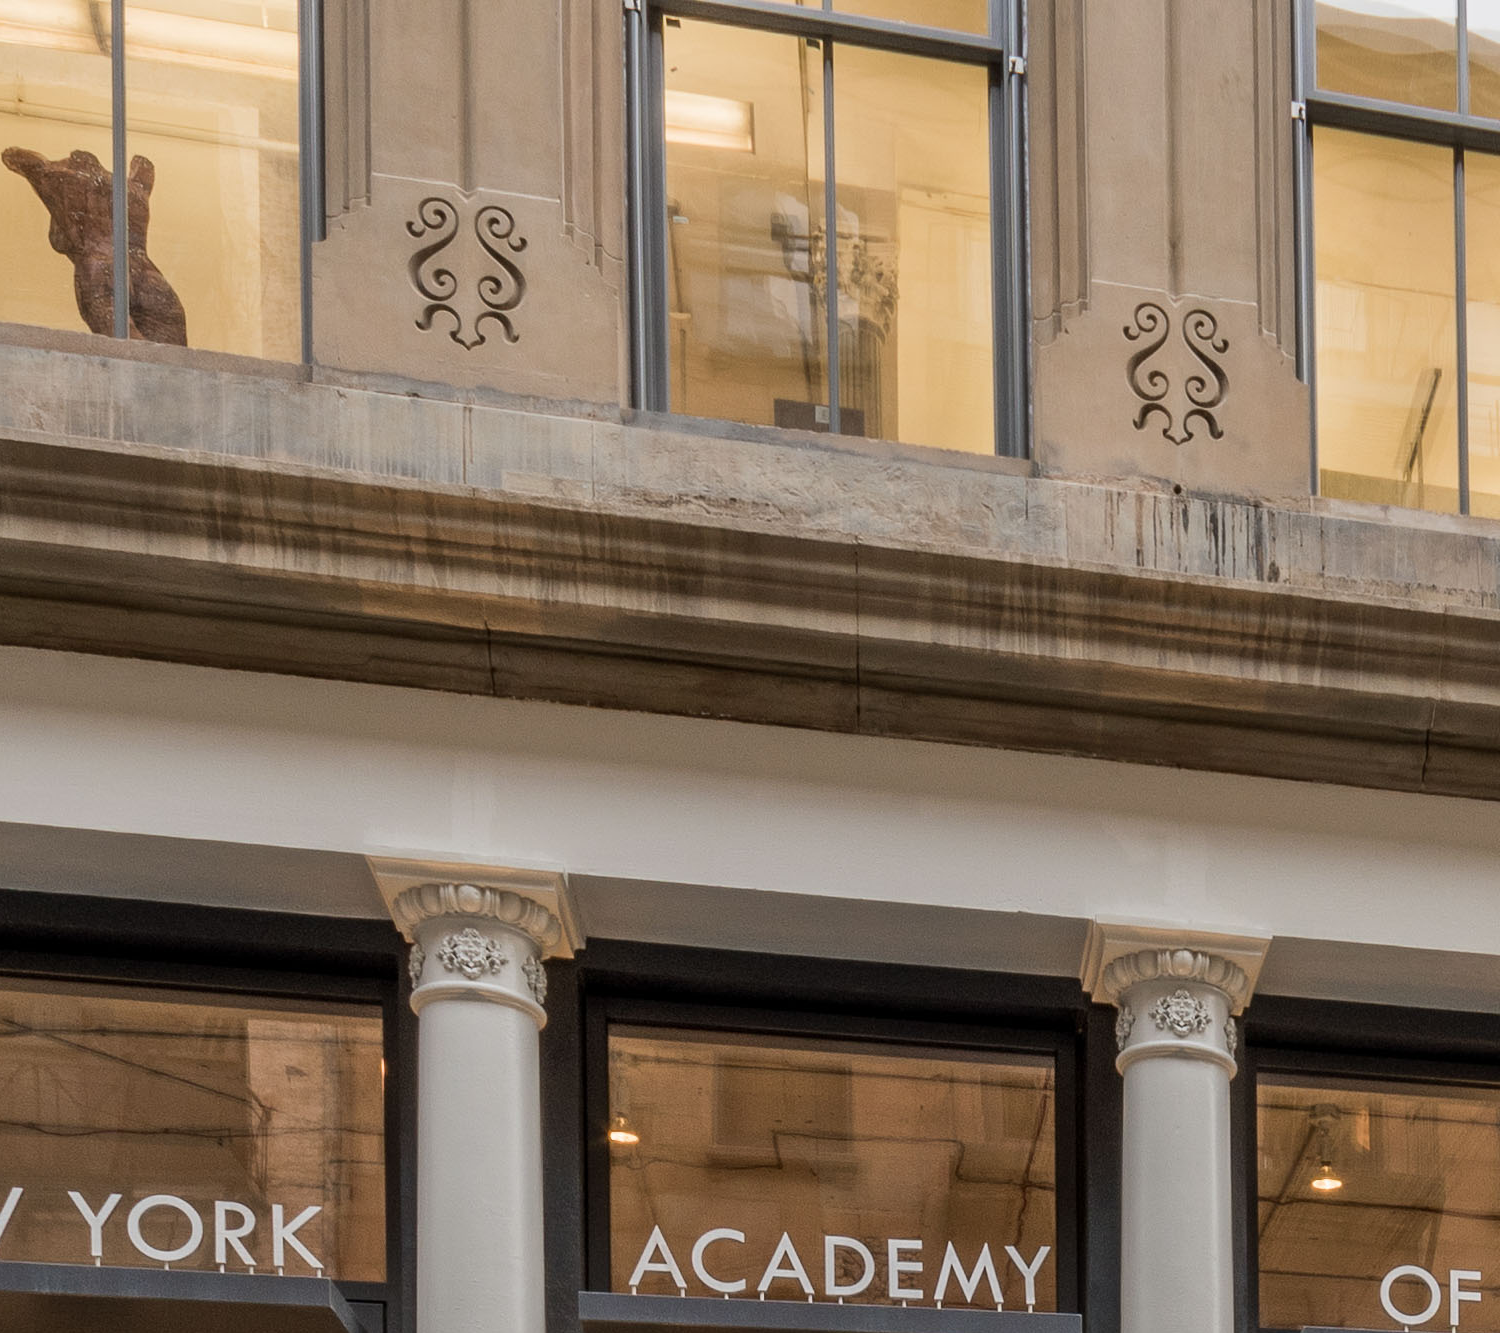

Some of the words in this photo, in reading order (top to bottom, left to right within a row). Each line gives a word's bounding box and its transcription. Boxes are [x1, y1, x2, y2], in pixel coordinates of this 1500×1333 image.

[67, 1192, 323, 1269] YORK
[628, 1224, 1051, 1305] ACADEMY
[1379, 1264, 1482, 1326] OF
